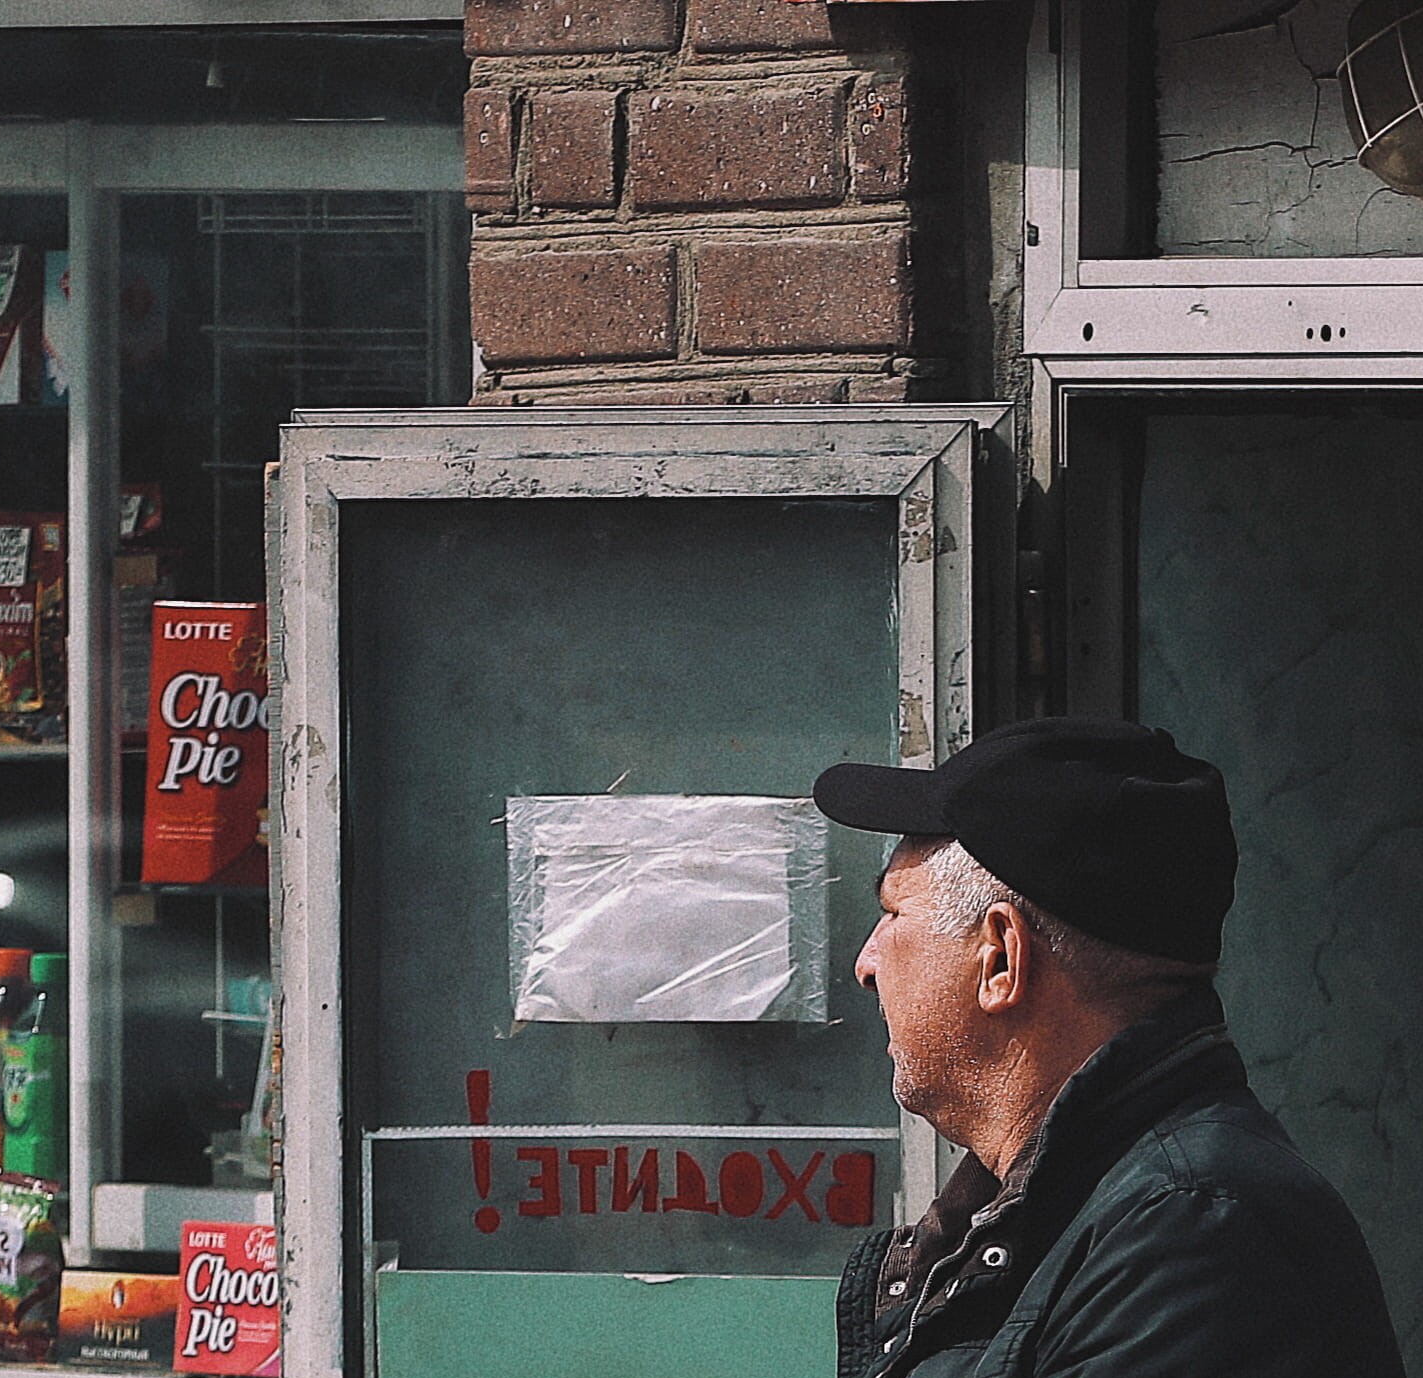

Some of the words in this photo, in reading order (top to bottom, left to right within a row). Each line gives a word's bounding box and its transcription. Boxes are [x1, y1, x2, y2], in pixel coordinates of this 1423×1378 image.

[163, 621, 233, 641] LOTTE
[157, 732, 242, 791] Pie
[188, 1230, 227, 1249] LOTTE
[186, 1253, 279, 1307] Choco
[181, 1305, 238, 1358] Pie
